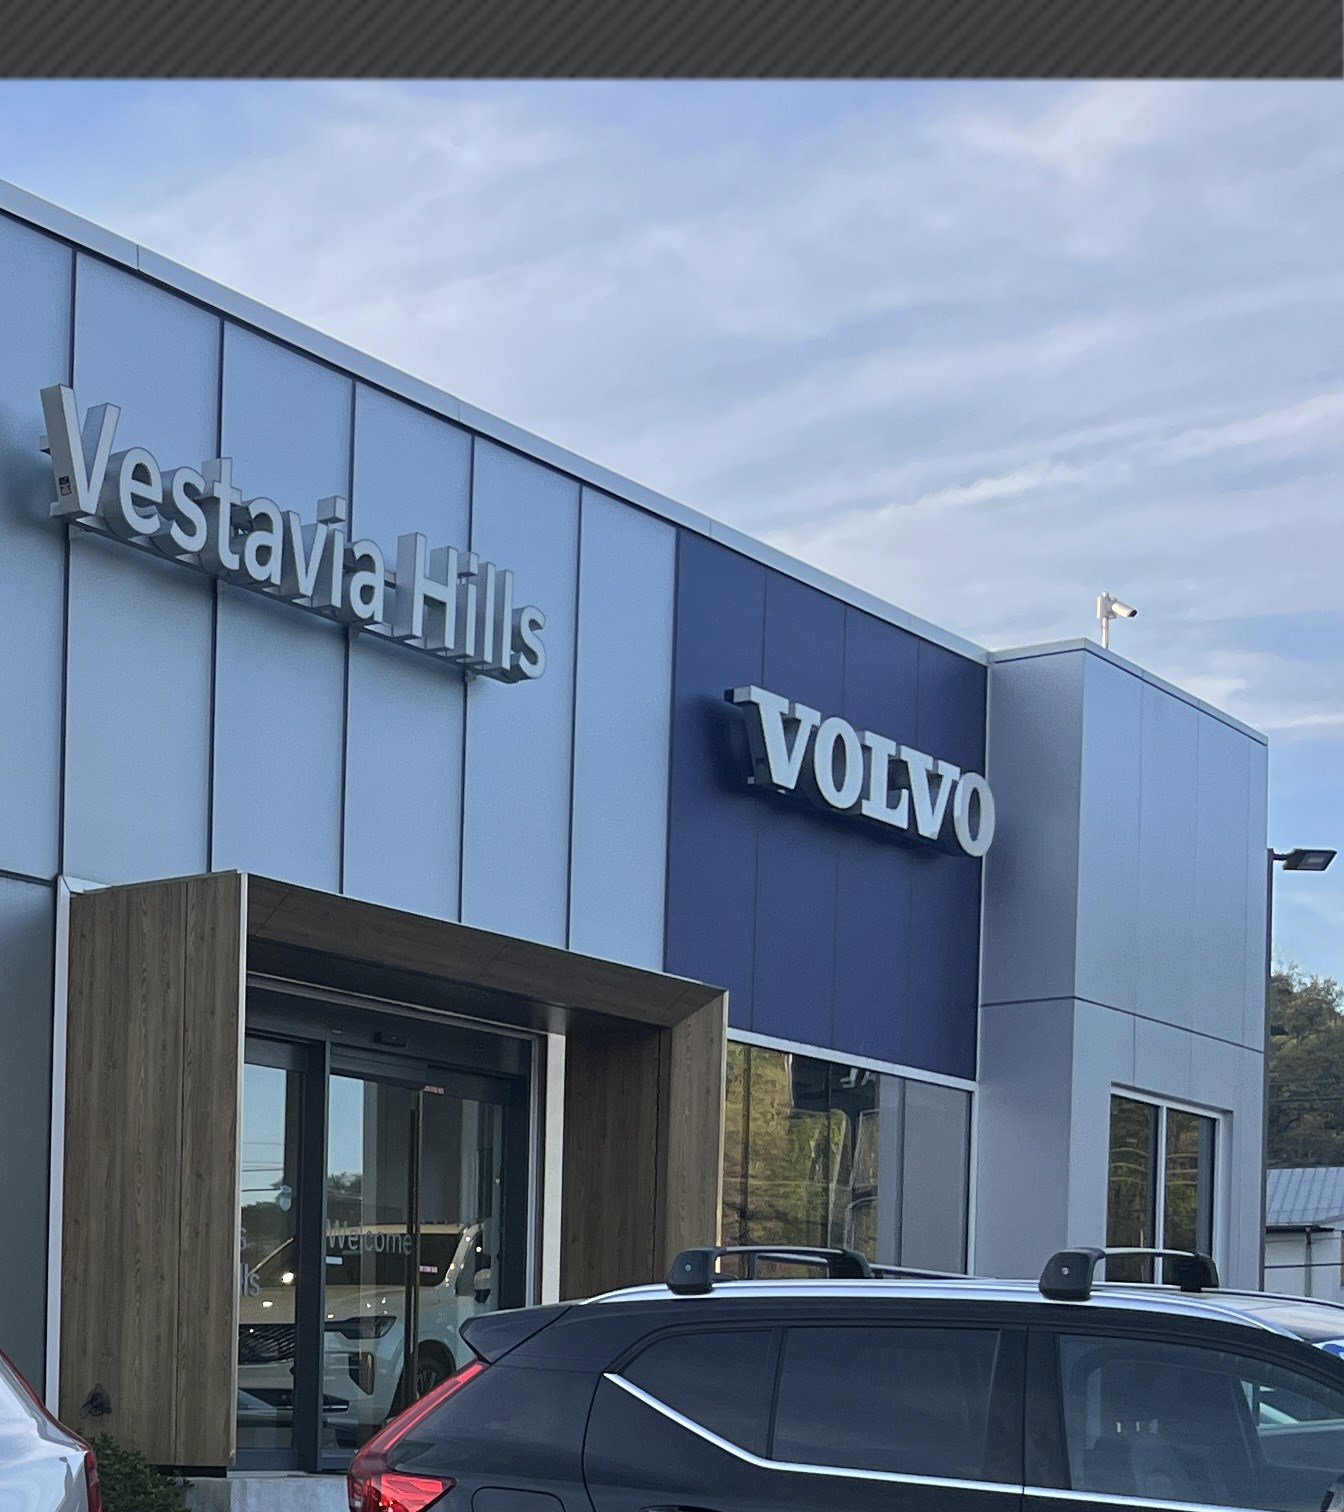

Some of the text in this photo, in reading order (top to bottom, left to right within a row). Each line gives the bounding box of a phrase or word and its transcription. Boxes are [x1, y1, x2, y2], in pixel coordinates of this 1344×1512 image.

[44, 384, 546, 680] Vestavia Hills
[742, 685, 996, 857] VOLVO
[326, 1219, 413, 1254] Welcome
